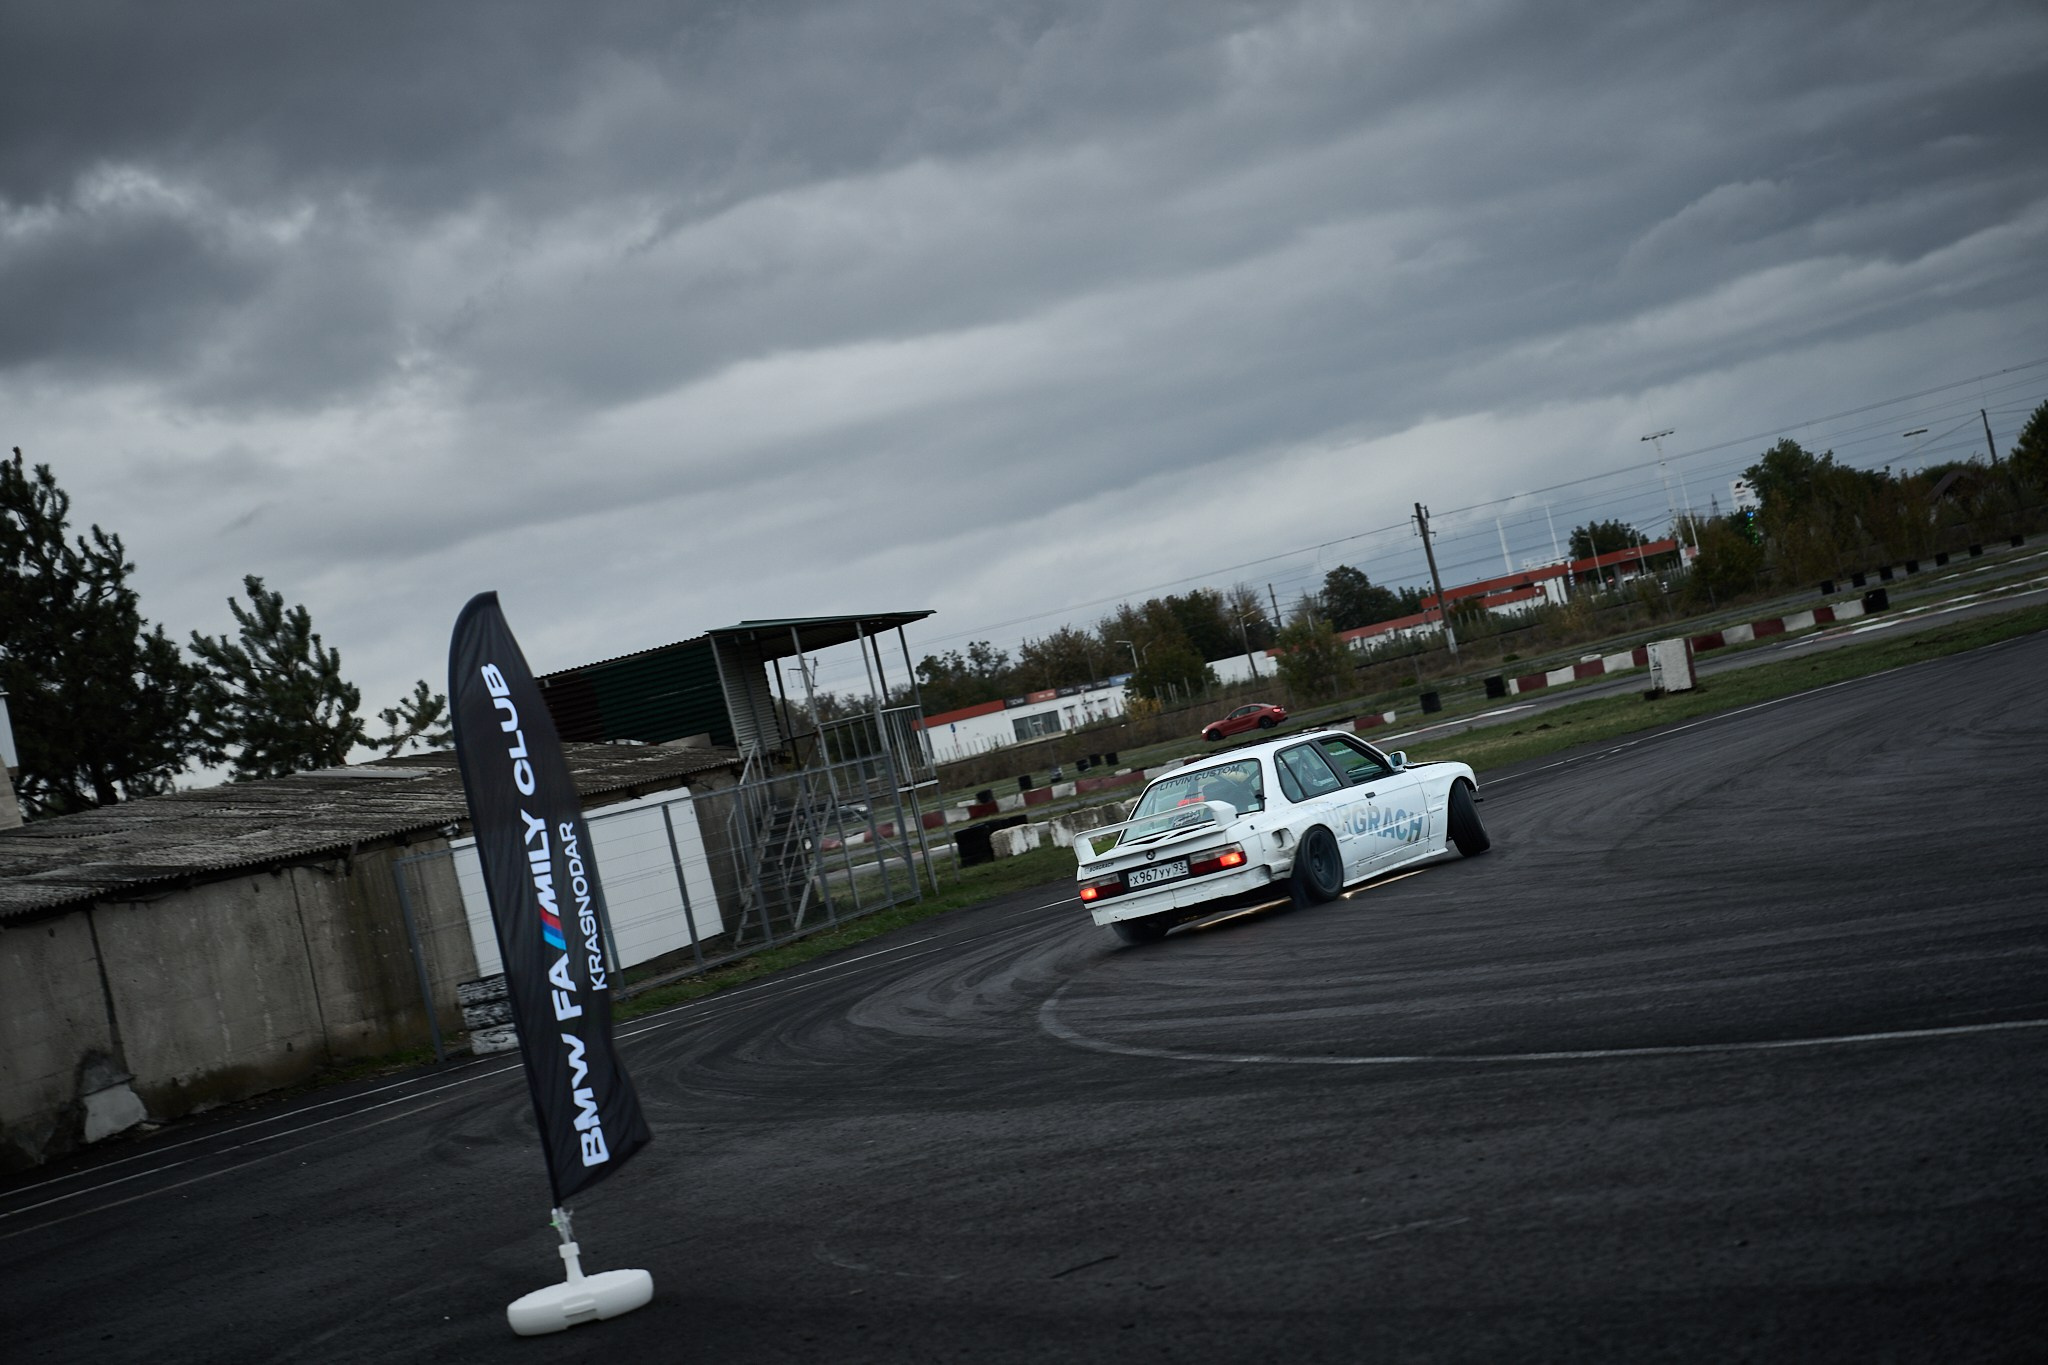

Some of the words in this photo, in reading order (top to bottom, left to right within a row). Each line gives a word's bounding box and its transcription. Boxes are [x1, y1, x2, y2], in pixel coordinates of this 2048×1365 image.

[480, 662, 536, 796] CLUB
[1159, 775, 1192, 791] LITVIN
[1194, 764, 1240, 781] CUSTOM
[1315, 804, 1423, 842] ORGRACH
[520, 808, 583, 1022] FAMILY
[558, 821, 608, 991] KRASNODAR
[560, 1033, 610, 1168] BMW
